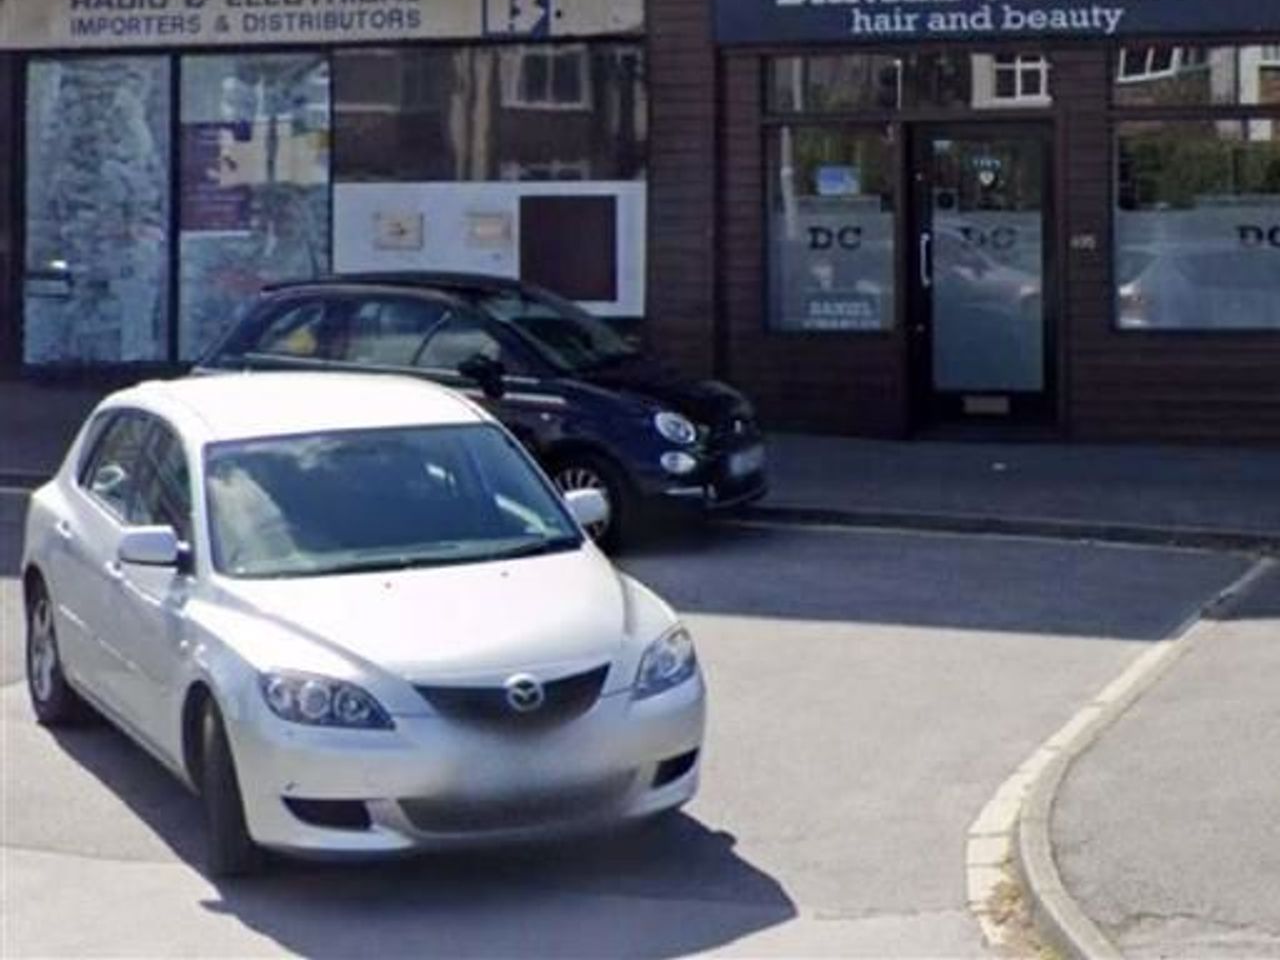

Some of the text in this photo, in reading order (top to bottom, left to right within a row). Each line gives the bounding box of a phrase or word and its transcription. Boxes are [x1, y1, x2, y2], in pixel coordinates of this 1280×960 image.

[70, 14, 201, 37] IMPORTERS
[242, 8, 422, 34] DISTRIBUTORS
[852, 4, 1125, 33] hair and beauty
[808, 226, 862, 250] DC
